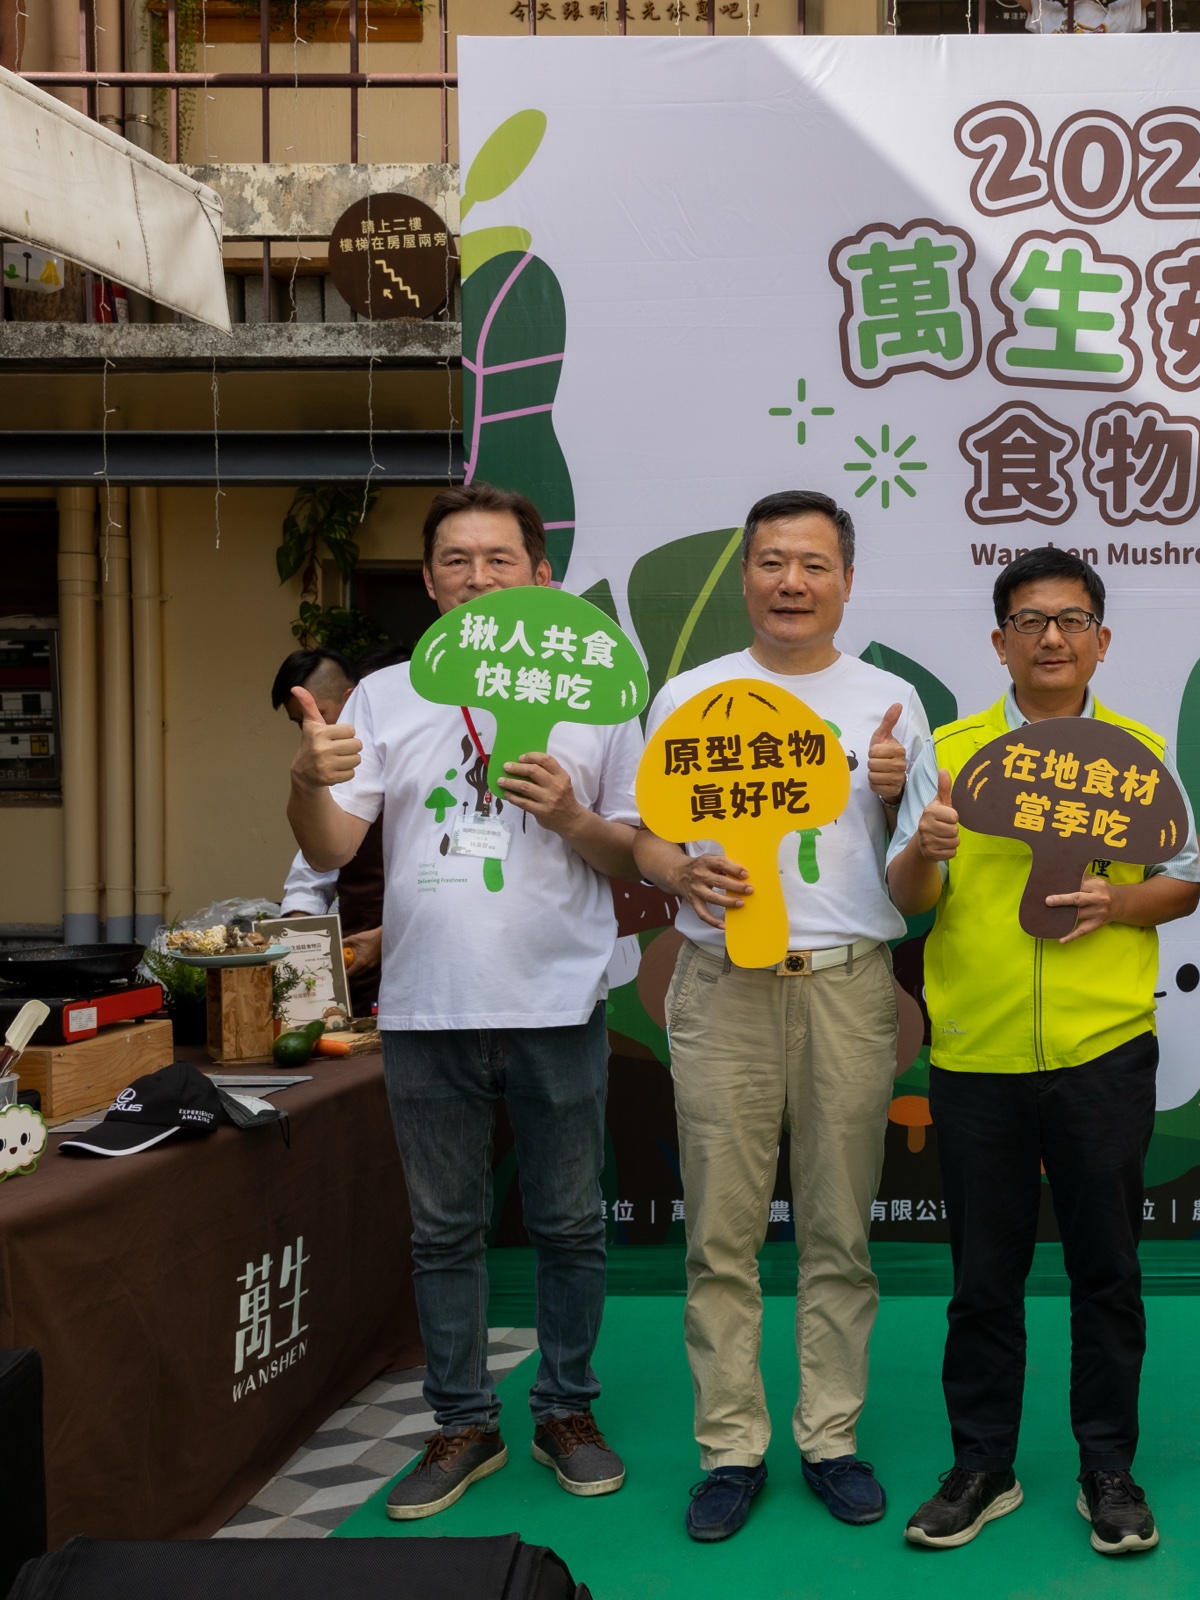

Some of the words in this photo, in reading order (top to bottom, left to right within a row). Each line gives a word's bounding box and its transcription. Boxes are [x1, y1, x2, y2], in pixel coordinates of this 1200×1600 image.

[339, 232, 447, 253] 樓梯在房屋兩旁
[360, 217, 423, 234] 請上二樓
[970, 541, 1098, 566] Wanen
[458, 612, 619, 669] 揪人共食
[474, 660, 593, 711] 快樂吃
[664, 729, 826, 776] 原型食物
[1002, 742, 1161, 806] 在地食材
[1013, 791, 1131, 848] 當季吃
[108, 1103, 143, 1112] EXUS
[178, 1108, 215, 1120] EXPERIENCE
[181, 1114, 211, 1124] AMAZING
[232, 1339, 308, 1403] WANSHEN
